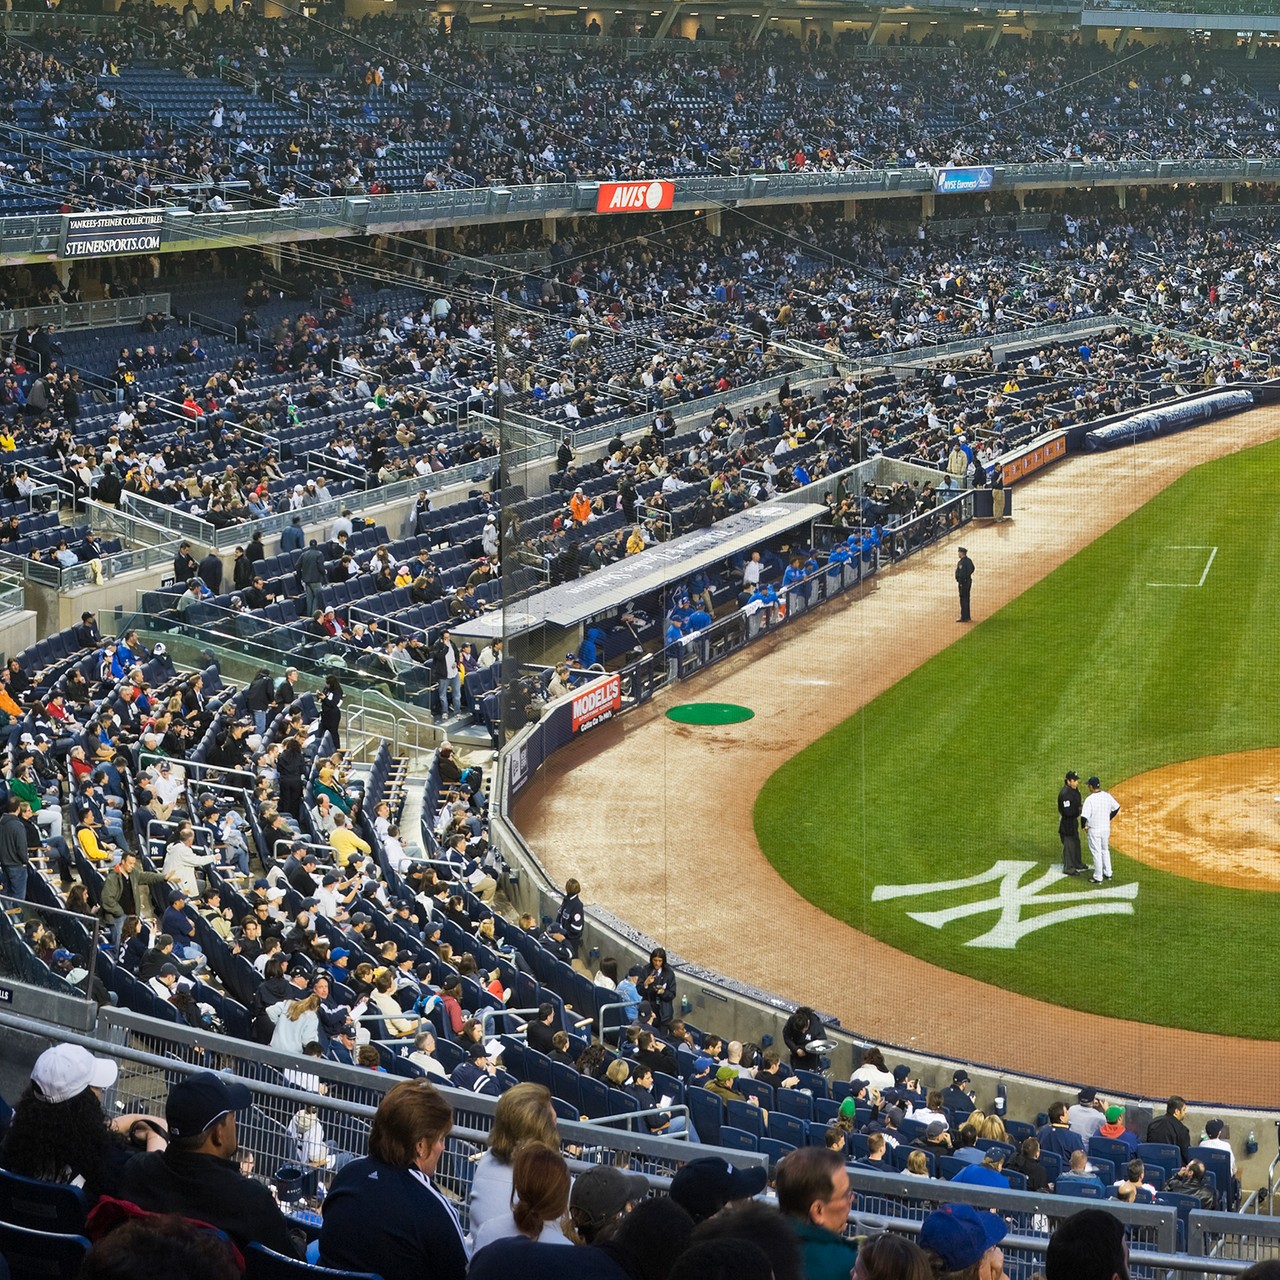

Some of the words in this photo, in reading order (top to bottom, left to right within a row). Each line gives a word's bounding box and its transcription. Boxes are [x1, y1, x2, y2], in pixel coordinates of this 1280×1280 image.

[608, 186, 647, 209] AVIS
[70, 217, 122, 229] YANKEES-STEINER
[123, 216, 163, 225] COLLECTIBLES
[65, 236, 160, 255] STEINERSPORTS.COM
[573, 680, 618, 720] MODELL'S
